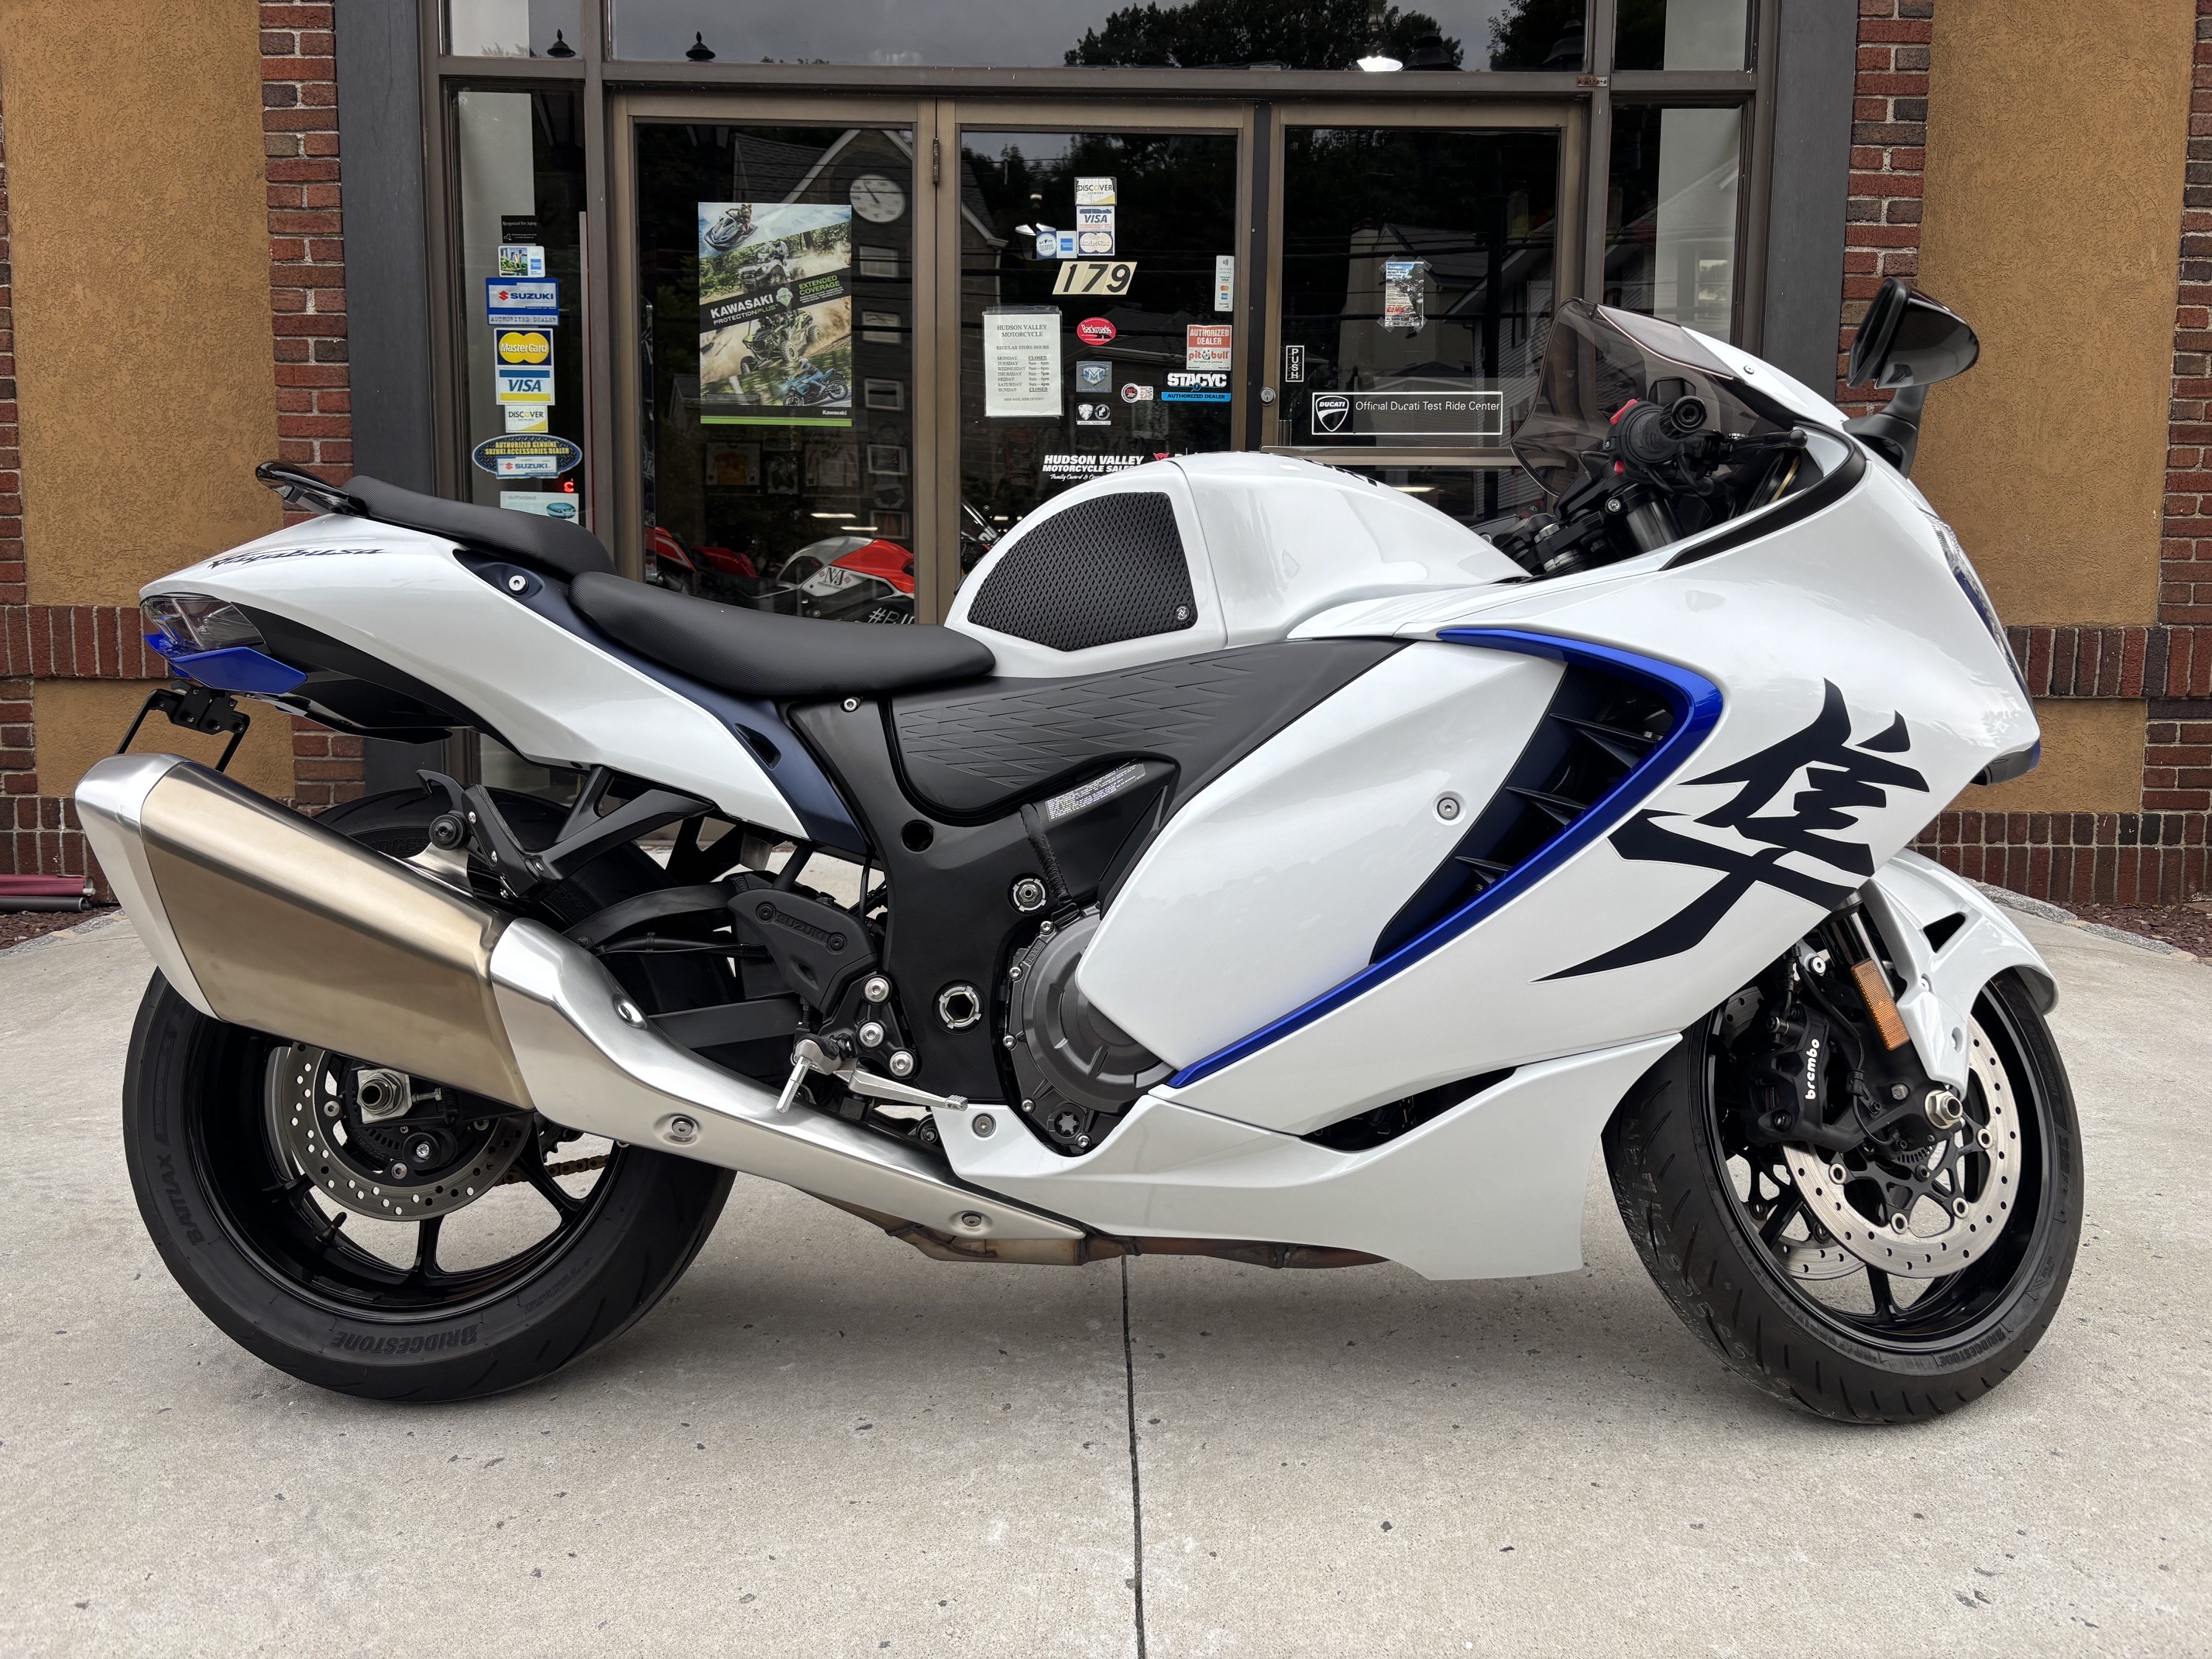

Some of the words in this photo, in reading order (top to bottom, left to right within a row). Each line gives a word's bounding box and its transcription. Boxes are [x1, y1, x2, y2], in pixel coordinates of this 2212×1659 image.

[1084, 215, 1108, 223] VISA
[799, 275, 838, 290] EXTENDED
[1062, 263, 1131, 293] 179
[799, 280, 841, 297] COVERAGE
[709, 294, 775, 319] KAWASAKI
[500, 342, 548, 353] MasterCard
[508, 379, 542, 392] VISA
[1166, 373, 1227, 387] STACYC
[1355, 400, 1388, 410] Official
[1390, 400, 1420, 410] Ducati
[1423, 400, 1442, 410] Test
[1445, 400, 1466, 410] Ride
[1468, 400, 1501, 410] Center
[1043, 455, 1097, 465] HUDSON
[1099, 455, 1145, 465] VALLEY
[775, 914, 826, 941] SUZUKI
[1805, 1039, 1819, 1100] brembo
[157, 1152, 206, 1246] BATTLAX
[331, 1323, 479, 1354] BRIDGESTONE
[1938, 1325, 2006, 1367] BRIDGESTONE
